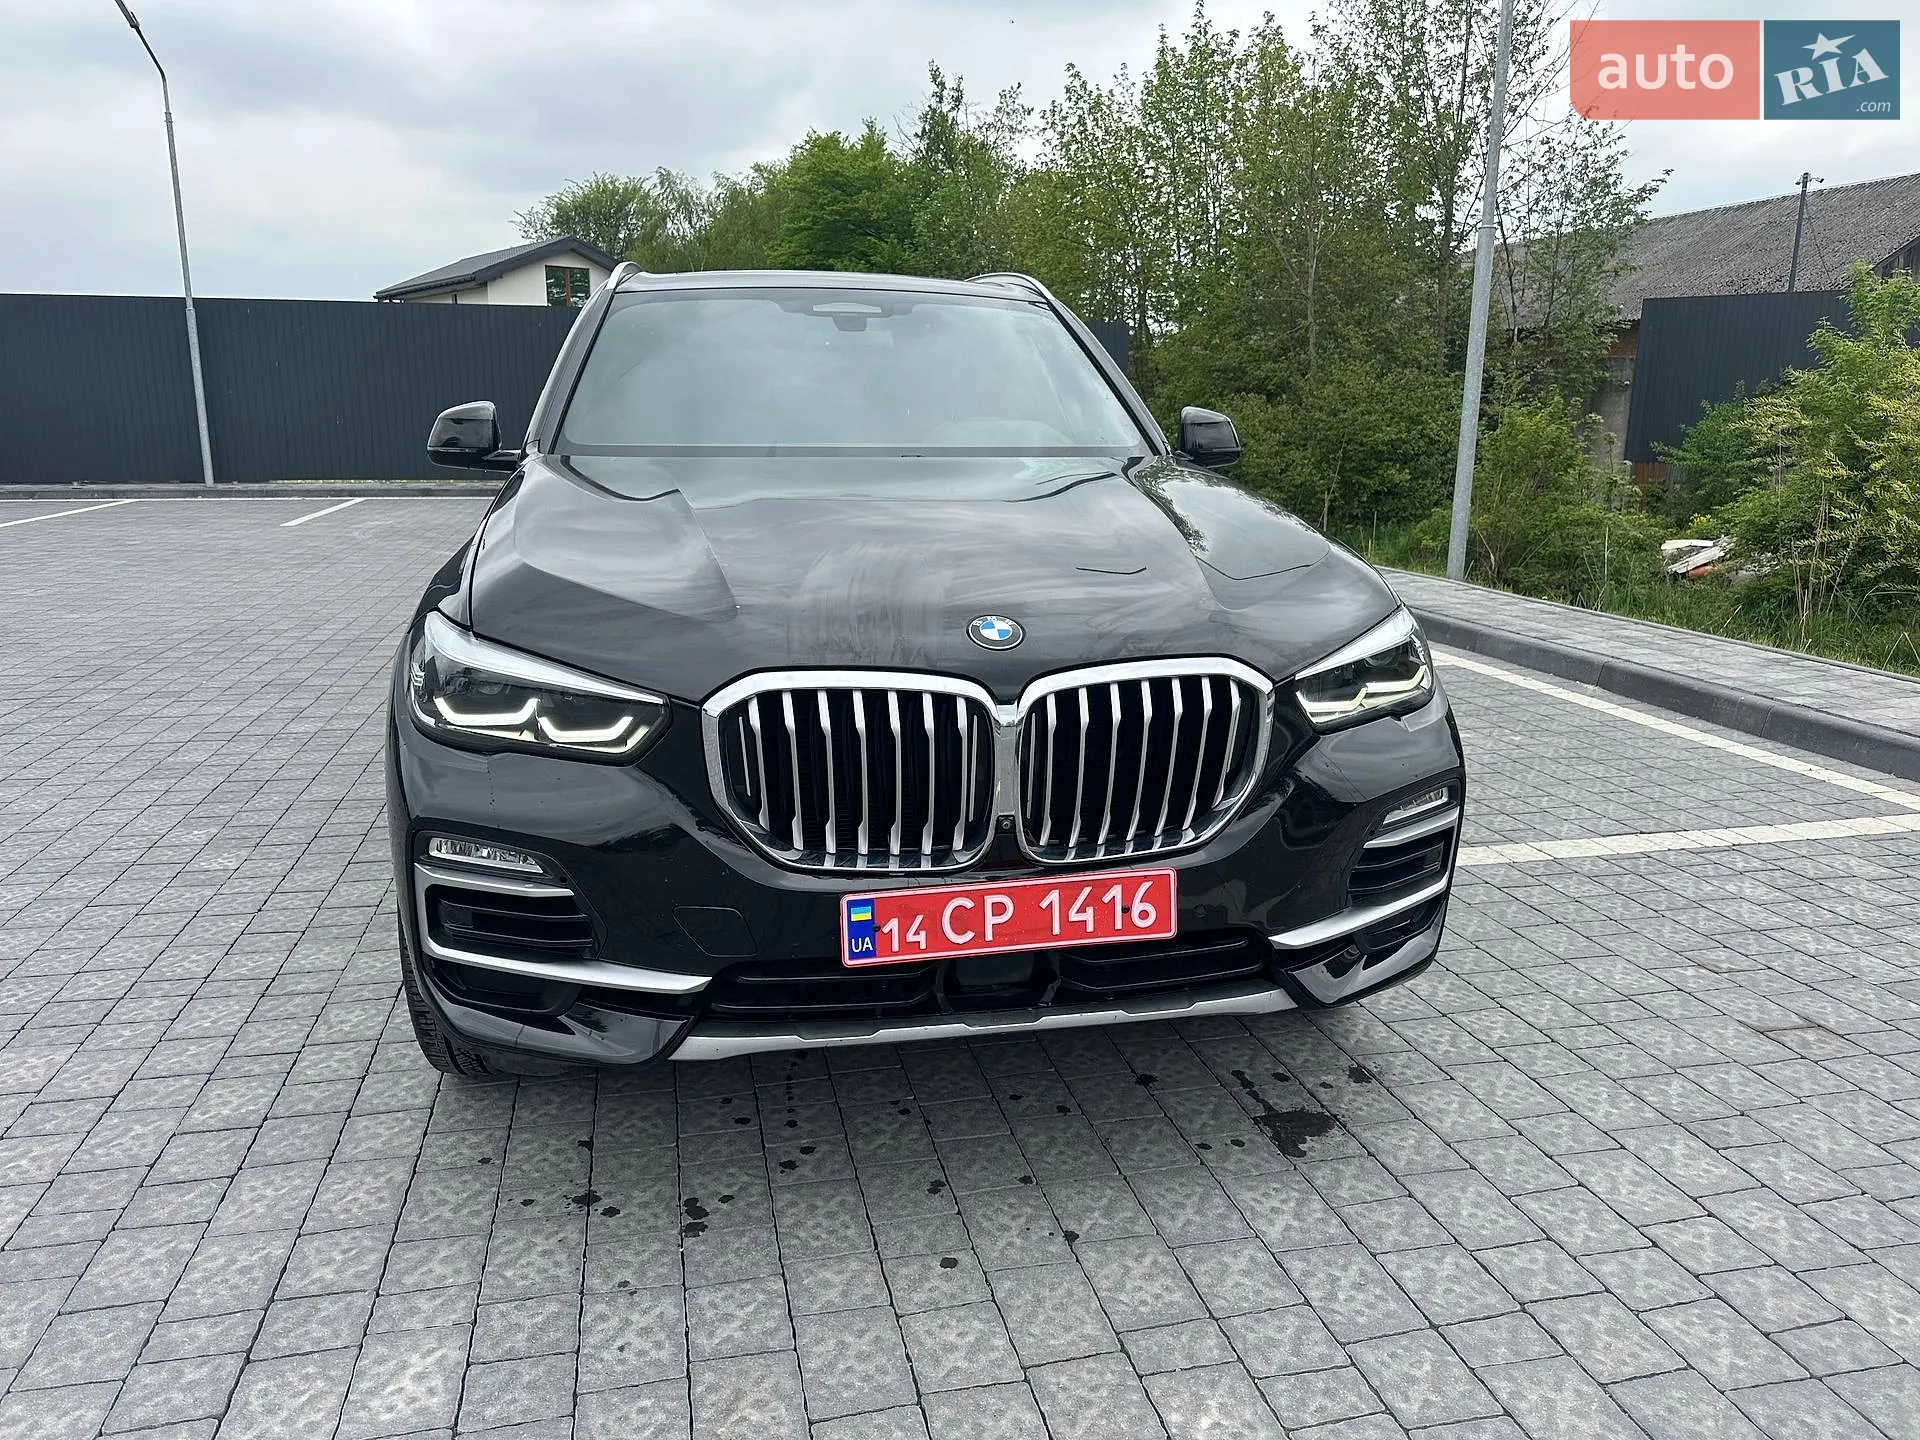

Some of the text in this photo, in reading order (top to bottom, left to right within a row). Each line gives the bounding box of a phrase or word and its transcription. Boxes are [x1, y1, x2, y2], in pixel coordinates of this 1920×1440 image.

[881, 881, 1157, 952] 14 CP 1416
[851, 937, 873, 952] UA
